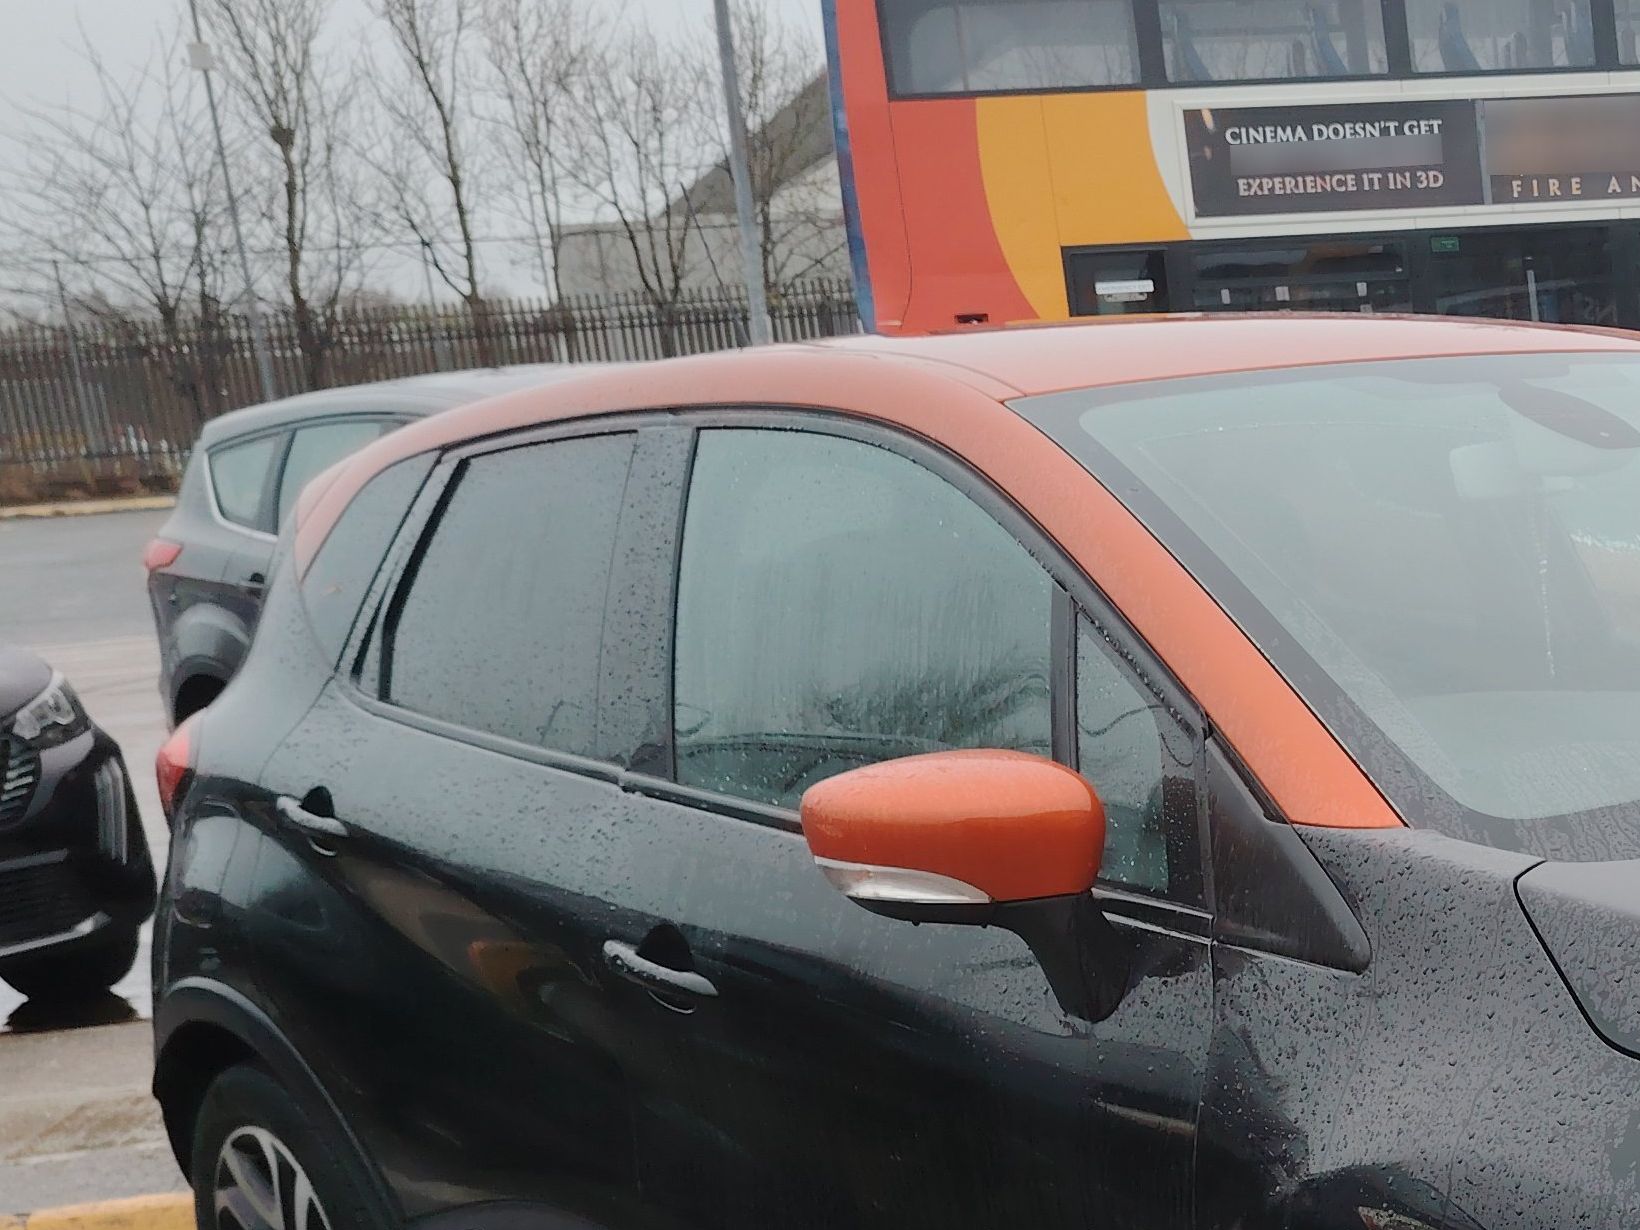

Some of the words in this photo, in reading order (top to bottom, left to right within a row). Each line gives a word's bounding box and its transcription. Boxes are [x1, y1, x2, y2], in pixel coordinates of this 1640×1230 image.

[1225, 124, 1308, 145] CINEMA
[1312, 120, 1399, 141] DOESN'T
[1403, 118, 1443, 136] GET
[1237, 174, 1357, 196] EXPERIENCE
[1361, 172, 1383, 191] IT
[1388, 170, 1411, 190] IN
[1416, 169, 1444, 189] 3D
[1511, 176, 1583, 198] FIRE
